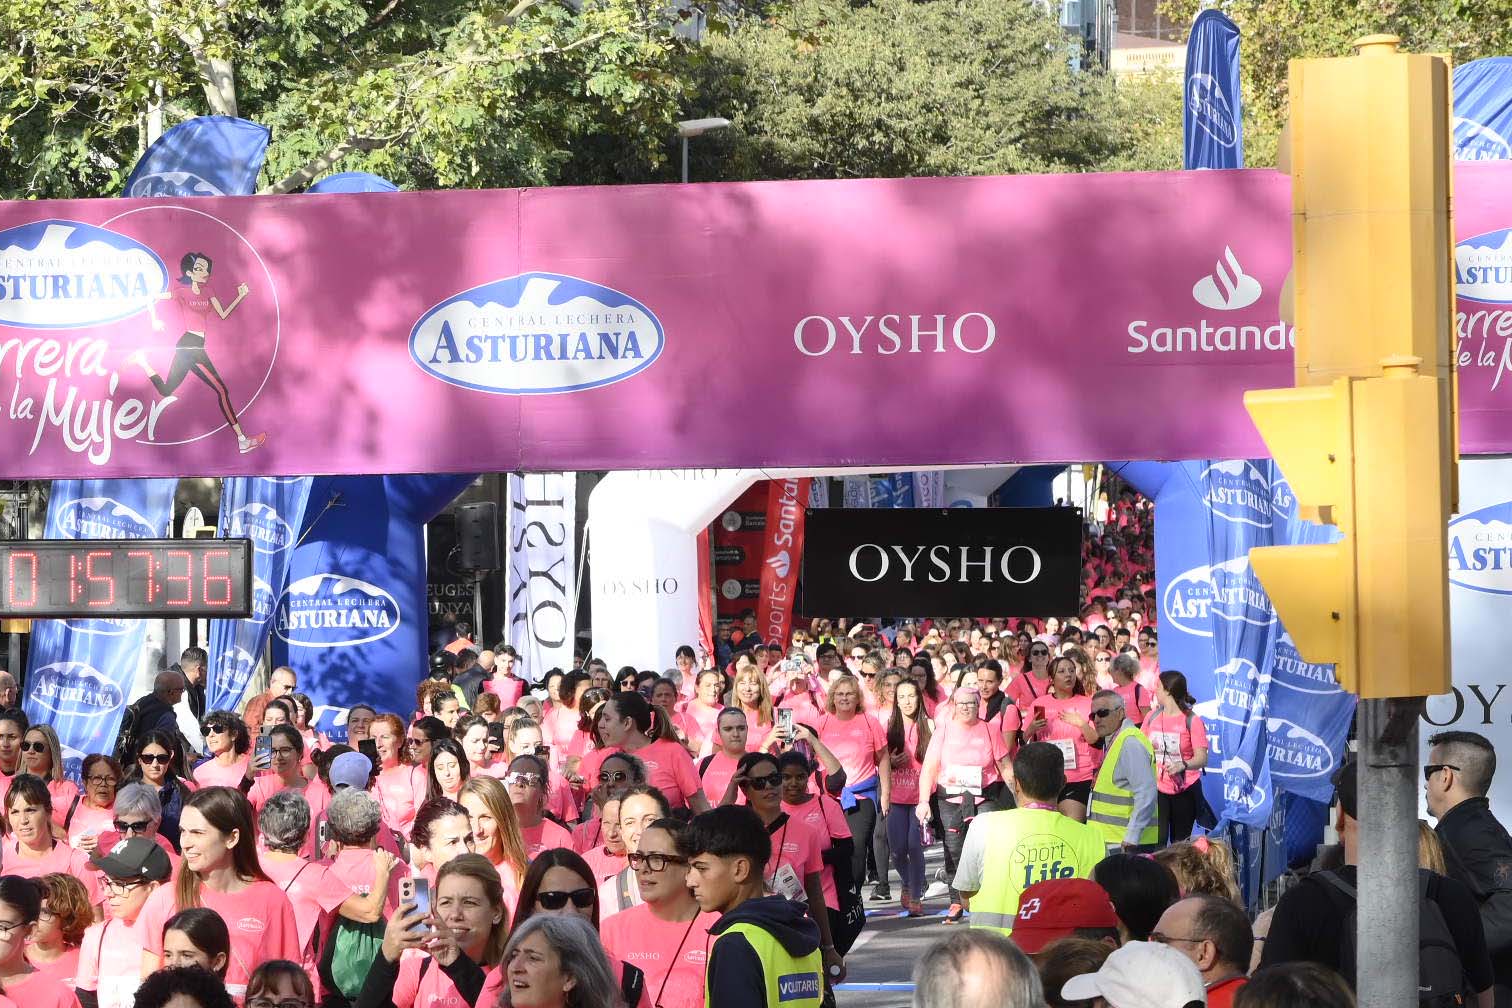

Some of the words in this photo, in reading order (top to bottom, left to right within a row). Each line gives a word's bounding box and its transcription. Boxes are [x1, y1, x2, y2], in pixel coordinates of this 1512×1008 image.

[467, 314, 546, 329] CENTRAL
[555, 312, 636, 326] LECHERA
[794, 311, 996, 358] OYSHO
[1127, 320, 1295, 354] Santand
[428, 319, 644, 364] ASTURIANA
[9, 381, 34, 420] la
[29, 371, 179, 466] Mujer
[9, 552, 234, 607] 01:57:36
[849, 543, 1042, 586] OYSHO
[279, 608, 391, 631] ASTURIANA
[290, 599, 333, 608] CENTRAL
[337, 598, 387, 607] LECHERA
[33, 675, 115, 708] ASTURIANA
[1014, 842, 1066, 869] Sport
[1023, 860, 1075, 889] Life
[627, 952, 660, 961] OYSHO
